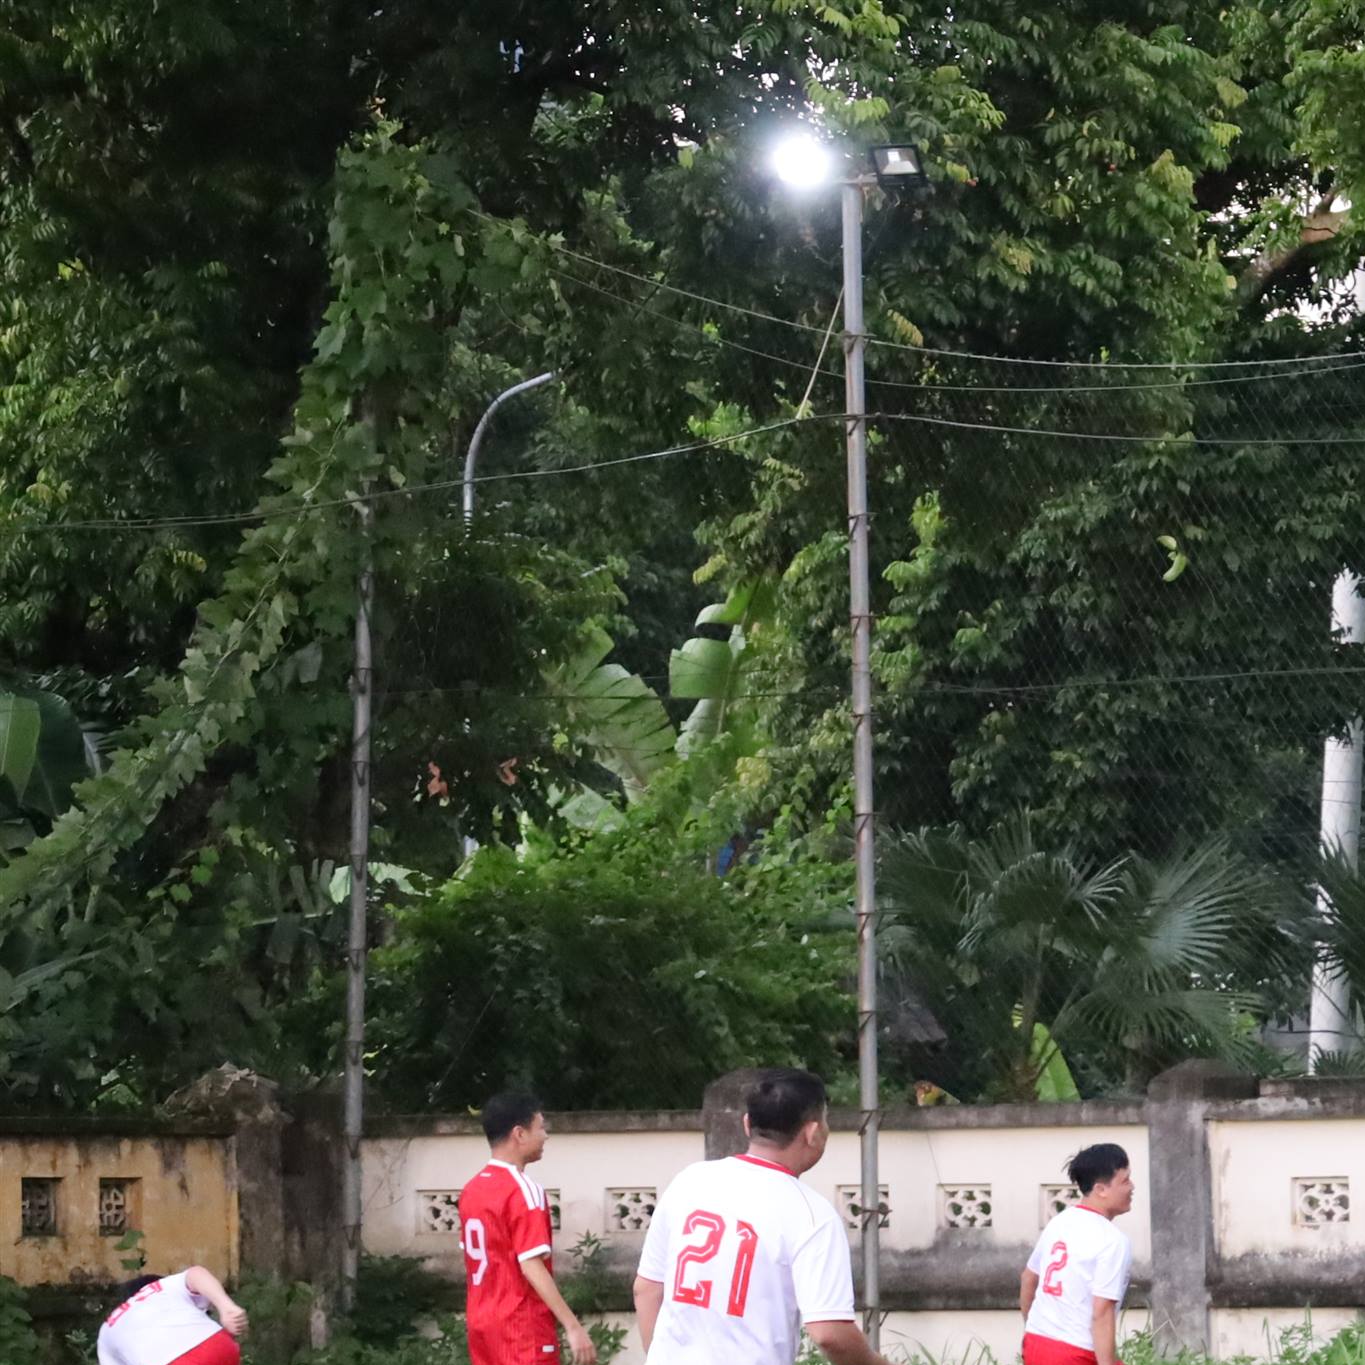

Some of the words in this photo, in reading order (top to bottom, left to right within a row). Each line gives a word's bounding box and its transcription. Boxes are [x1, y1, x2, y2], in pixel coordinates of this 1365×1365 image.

[465, 1218, 488, 1287] 9
[672, 1209, 759, 1318] 21
[1043, 1240, 1068, 1297] 2
